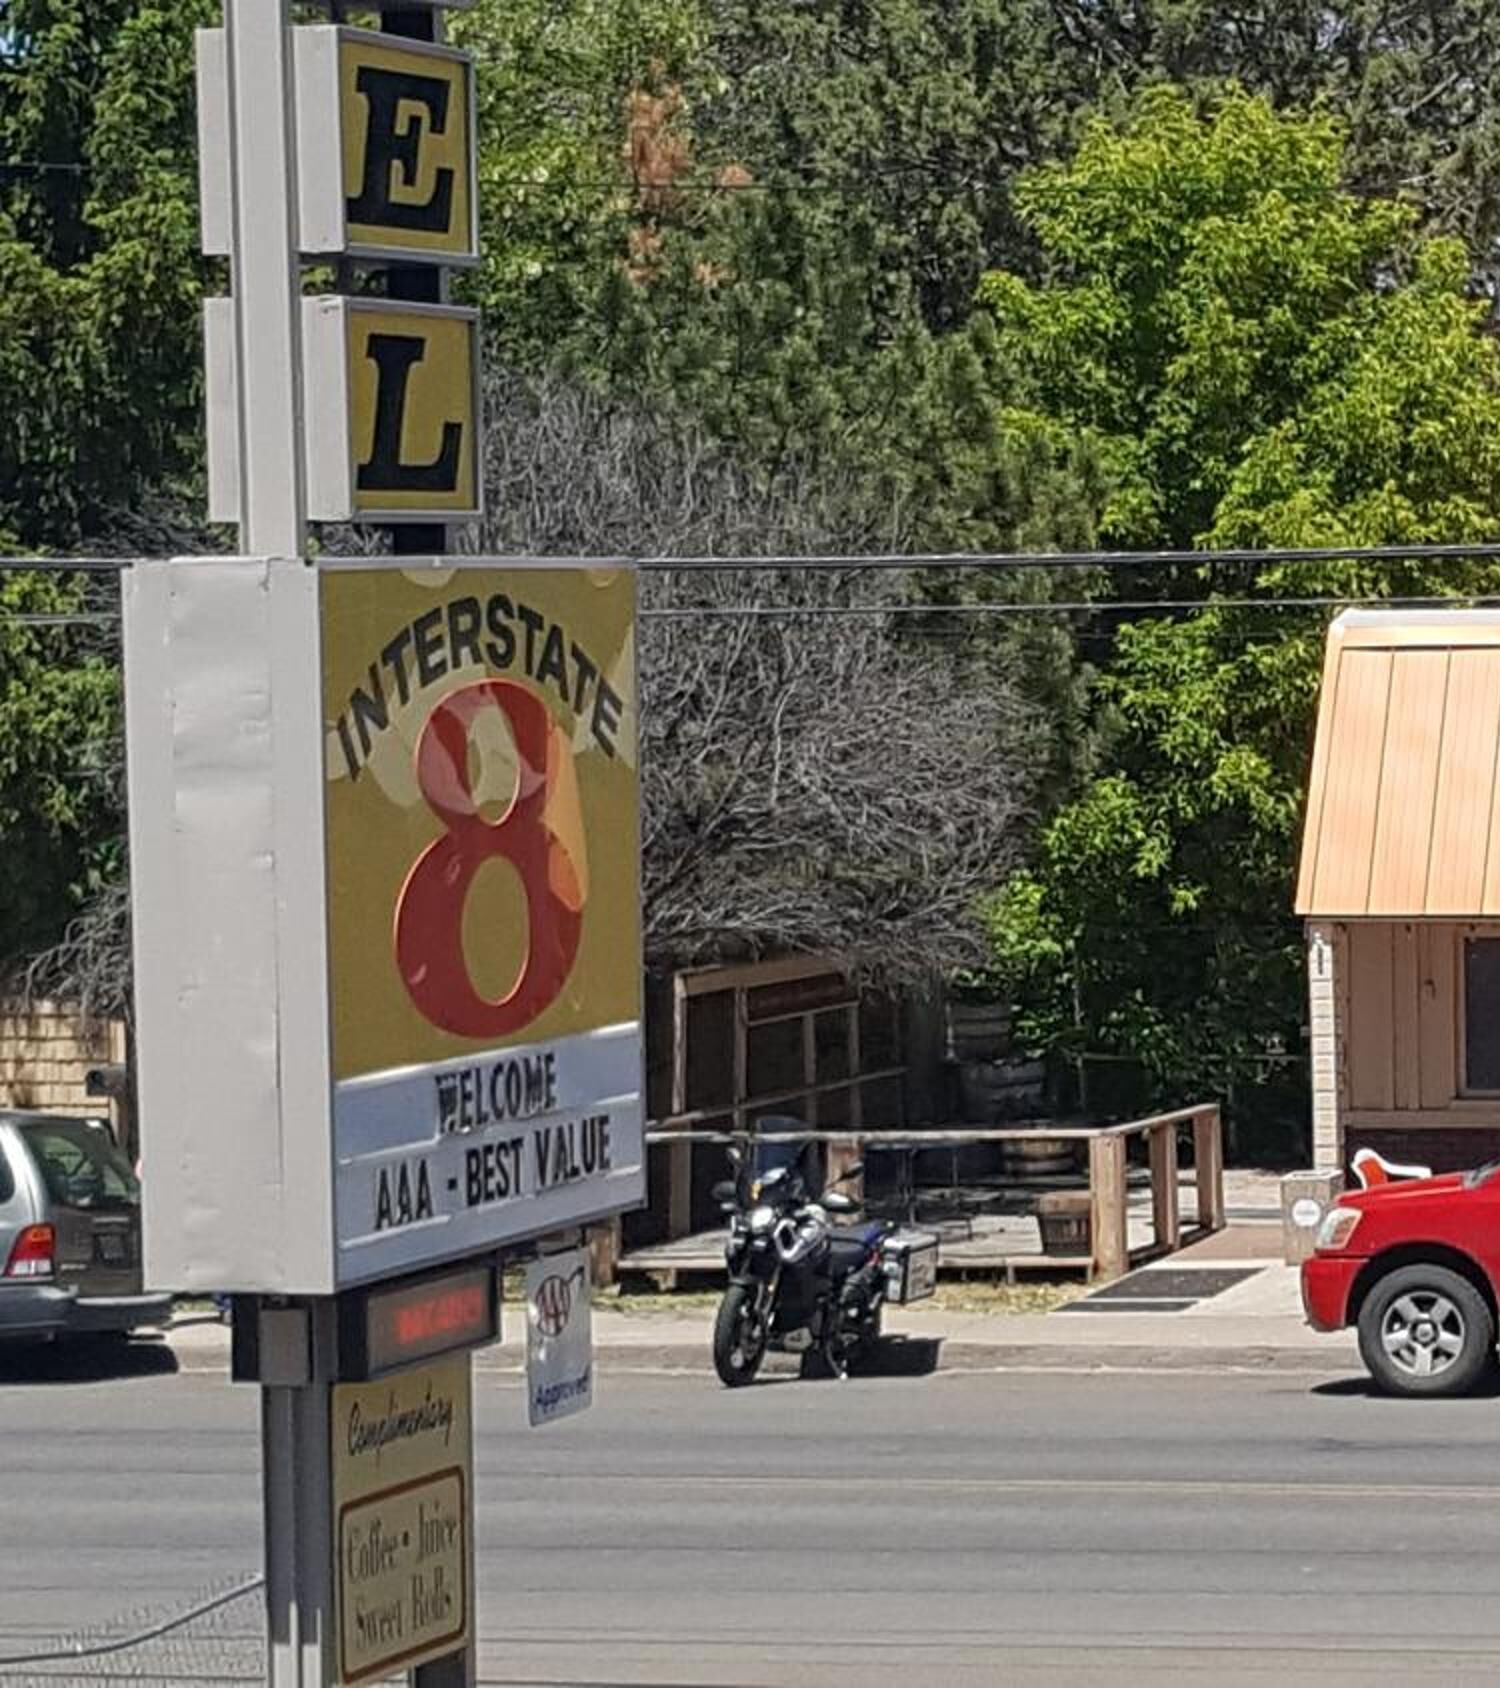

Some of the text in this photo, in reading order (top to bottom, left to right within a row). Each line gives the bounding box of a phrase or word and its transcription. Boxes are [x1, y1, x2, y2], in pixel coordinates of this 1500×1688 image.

[337, 594, 622, 782] INTERSTATE
[394, 678, 587, 1039] 8
[435, 1053, 557, 1134] WELCOME
[375, 1159, 434, 1230] AAA
[466, 1135, 525, 1208] BEST
[534, 1114, 611, 1186] VALUE
[349, 1500, 458, 1584] Coffee Juice
[355, 1565, 451, 1650] Sweet Rolls
